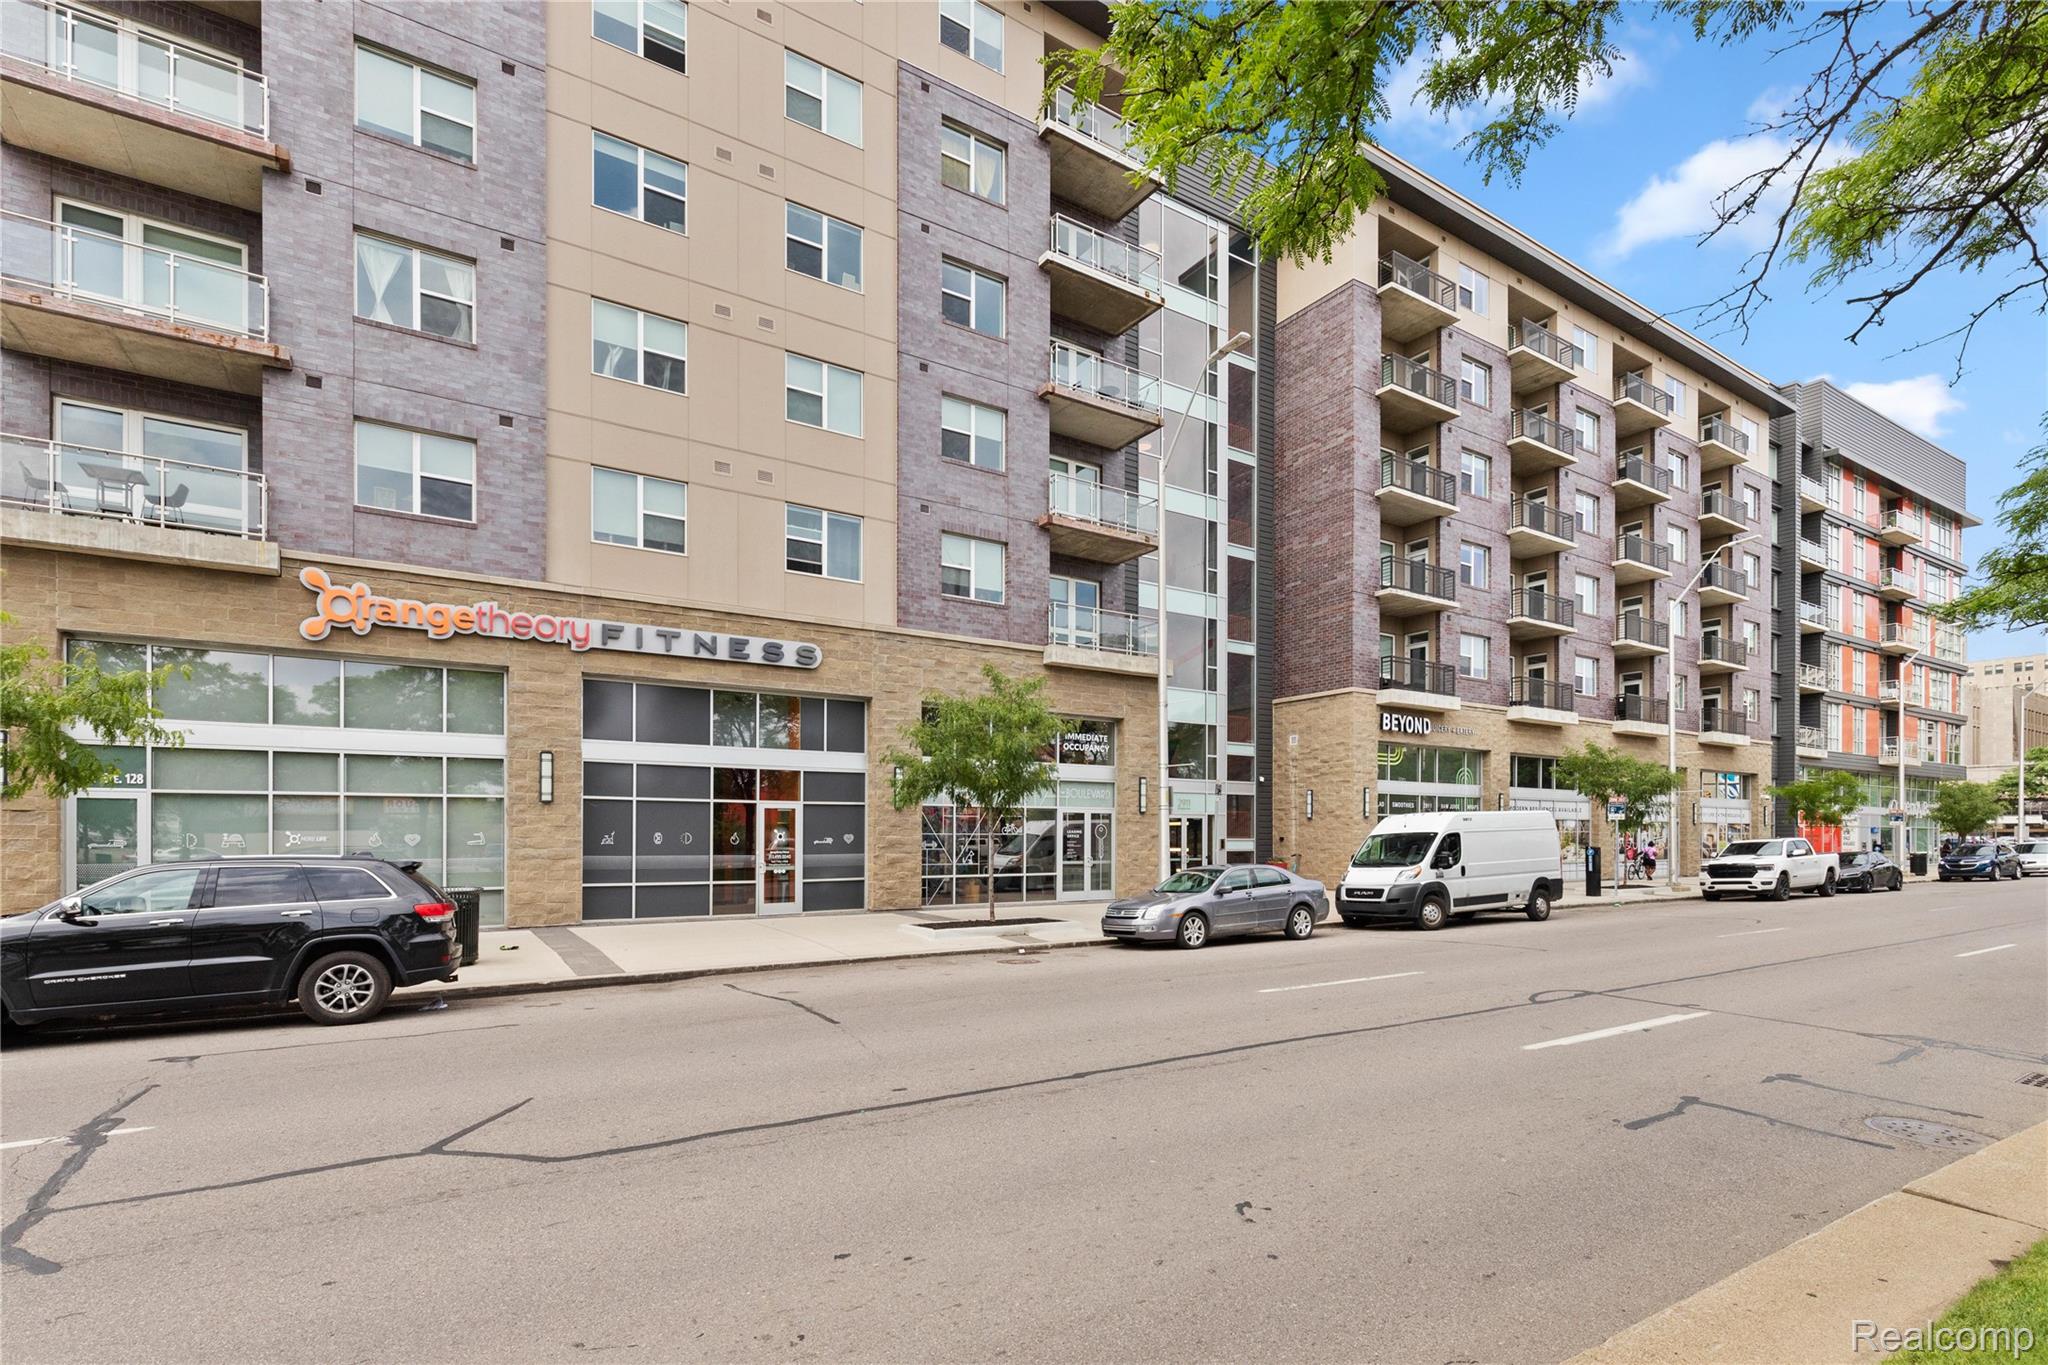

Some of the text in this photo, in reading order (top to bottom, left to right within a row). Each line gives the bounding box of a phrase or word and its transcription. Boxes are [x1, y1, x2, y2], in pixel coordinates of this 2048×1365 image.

[301, 567, 818, 668] Orangetheory FITNESS
[1382, 712, 1431, 734] BEYOND
[1064, 732, 1109, 744] IMMEDIATE
[1062, 742, 1110, 754] OCCUPANCY
[125, 773, 144, 785] 128
[1391, 801, 1415, 809] SMOOTHIES
[43, 973, 127, 985] GRAND CHEROKEE
